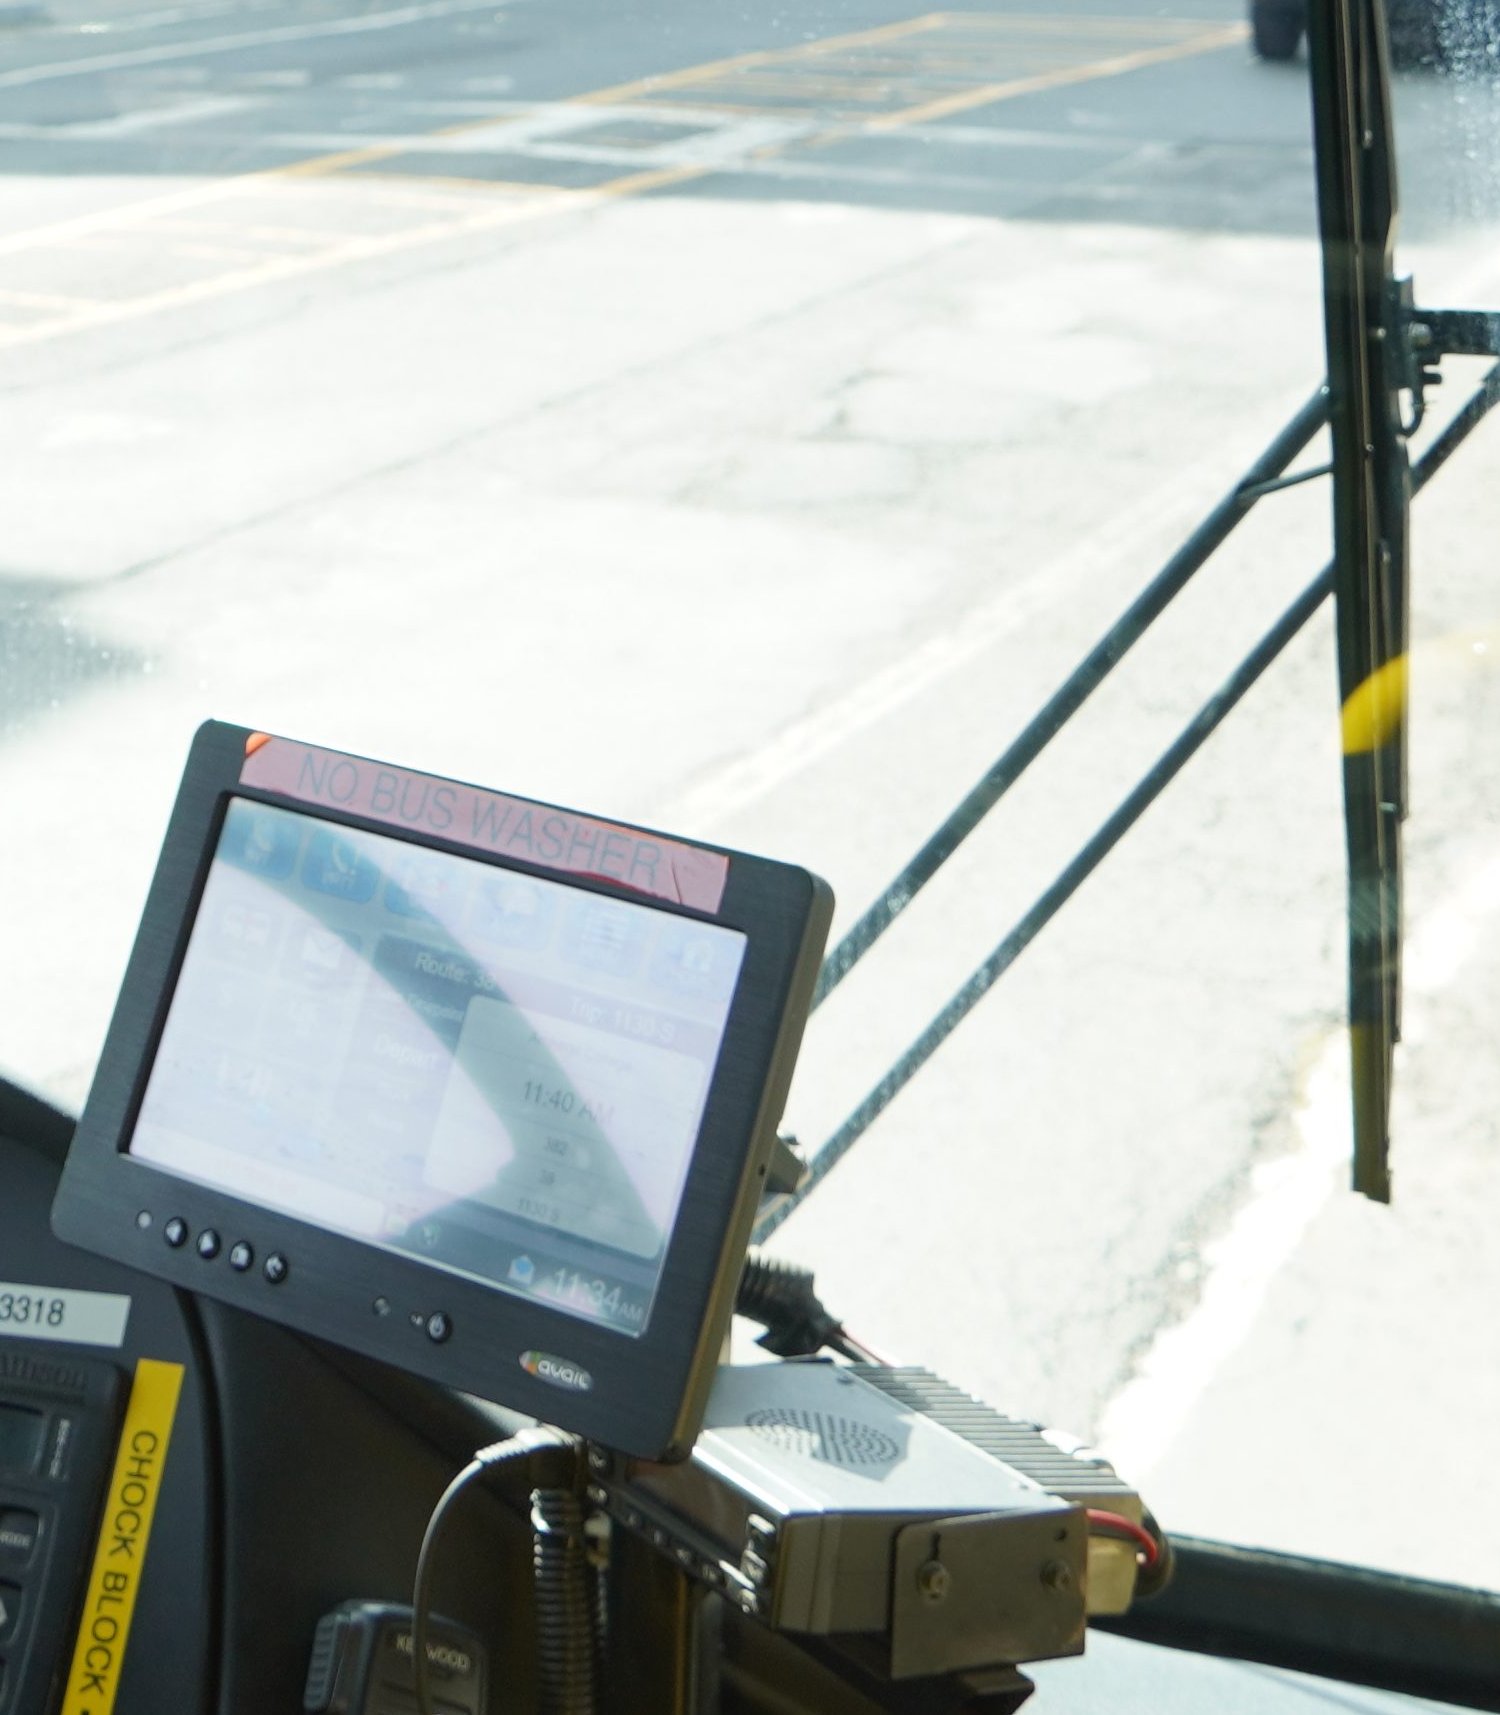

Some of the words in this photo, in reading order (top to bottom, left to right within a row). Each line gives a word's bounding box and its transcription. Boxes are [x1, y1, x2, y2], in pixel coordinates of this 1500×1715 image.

[299, 752, 361, 804] NO
[369, 772, 458, 831] BUS
[470, 792, 662, 889] WASHER
[523, 1080, 575, 1114] 11:40
[554, 1266, 623, 1314] 11:34
[107, 1430, 159, 1558] CHOCK
[78, 1570, 129, 1697] BLOCK
[396, 1633, 472, 1673] KEWOOD
